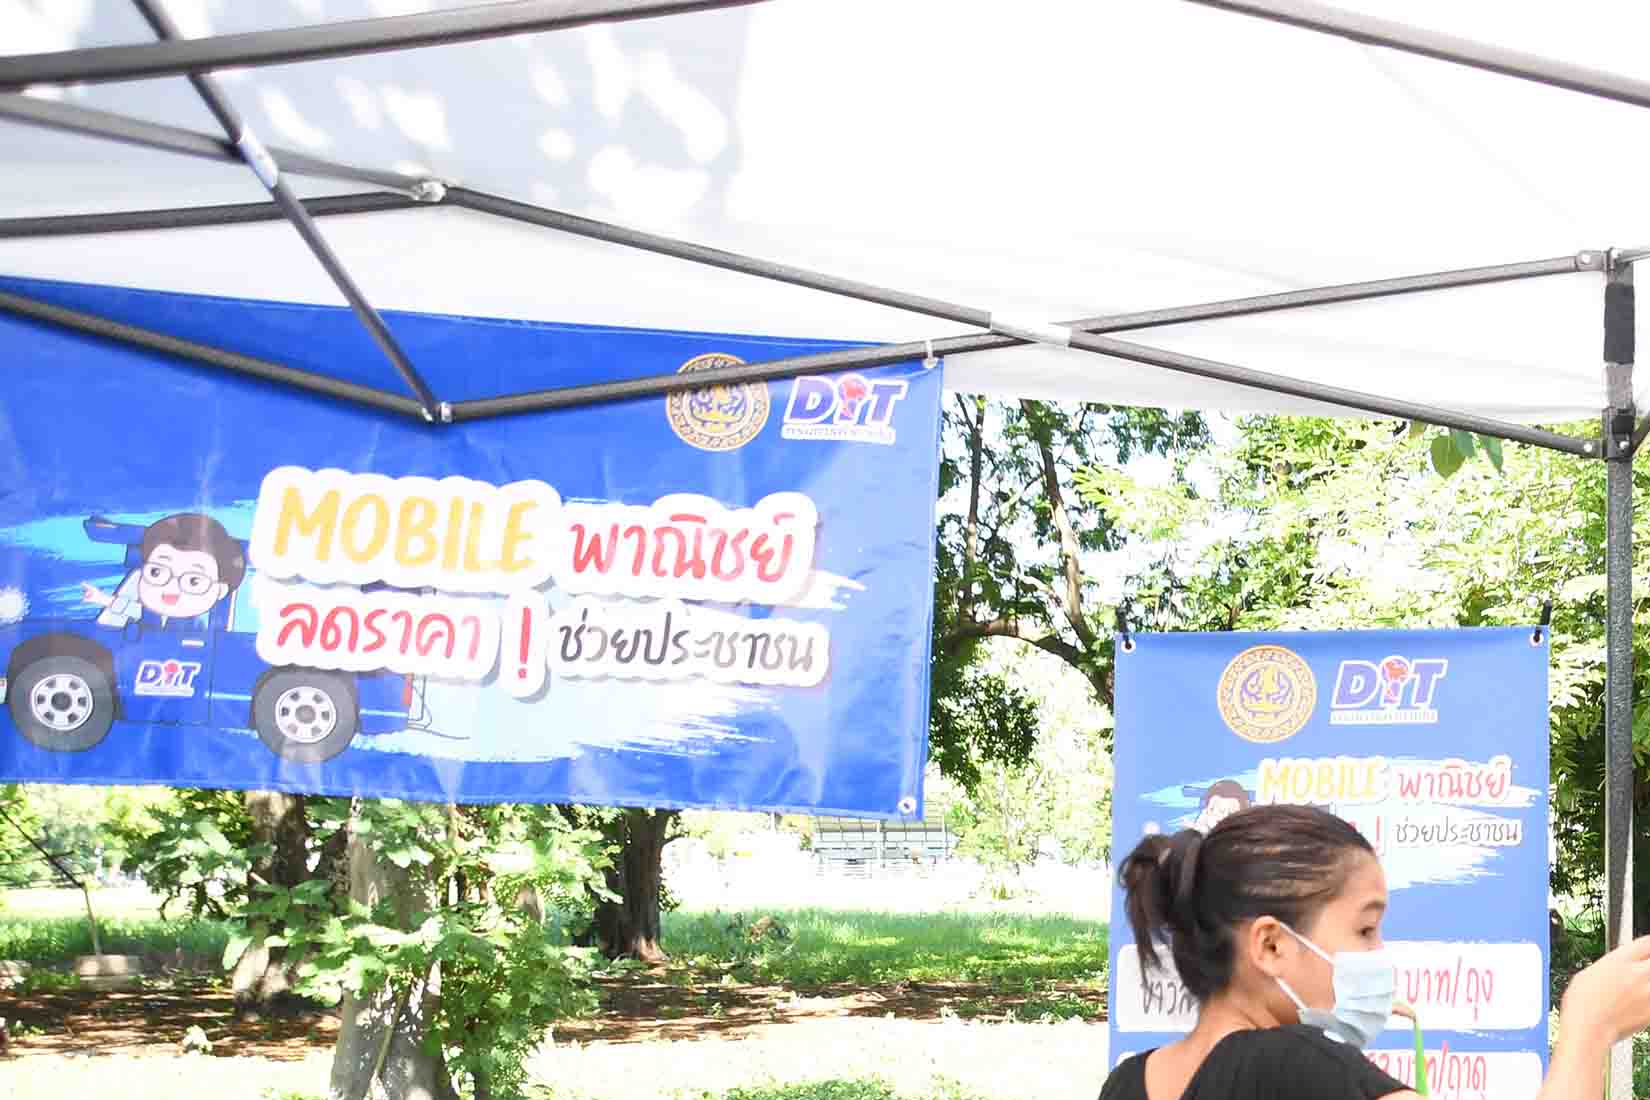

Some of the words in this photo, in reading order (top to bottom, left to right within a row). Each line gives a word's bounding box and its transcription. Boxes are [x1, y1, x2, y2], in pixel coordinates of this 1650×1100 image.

[272, 484, 540, 574] MOBILE
[569, 511, 798, 583] พาณิชย์
[276, 602, 481, 661] ลดราคา
[558, 607, 815, 672] ช่วยประชาชน
[1262, 762, 1381, 799] MOBILE
[1398, 761, 1505, 799] พาณิชย์
[1396, 814, 1519, 843] ช่วยประชาชน
[1404, 955, 1493, 1022] บาท/ถุง
